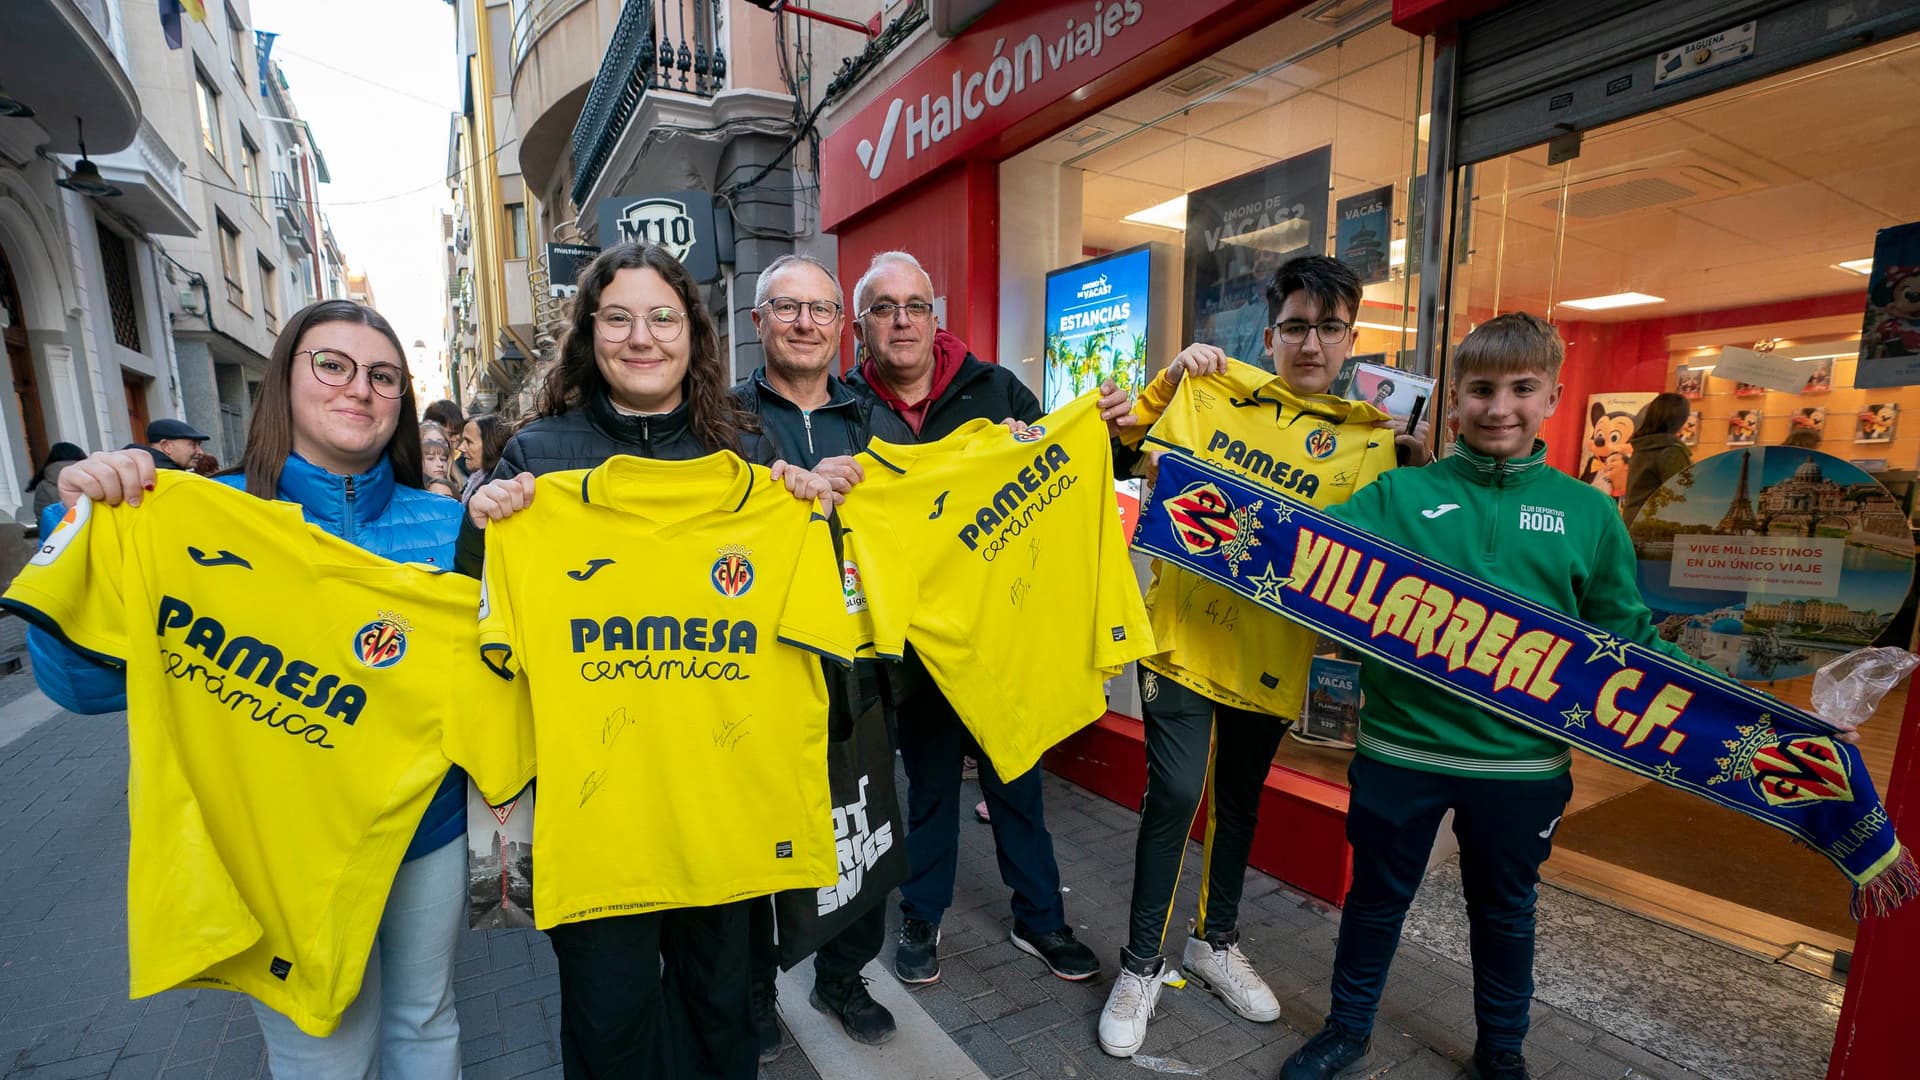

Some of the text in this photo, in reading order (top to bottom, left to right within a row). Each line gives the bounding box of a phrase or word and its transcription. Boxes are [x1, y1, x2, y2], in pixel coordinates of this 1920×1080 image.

[905, 0, 1143, 160] Halcón viajes
[1265, 195, 1280, 208] DE
[1345, 201, 1383, 220] VACAS
[619, 215, 690, 246] M10
[1060, 302, 1130, 332] ESTANCIAS
[1207, 429, 1320, 499] PAMESA
[957, 442, 1071, 551] PAMESA
[1520, 504, 1535, 513] CLUB
[982, 473, 1078, 563] cerámica
[1519, 511, 1565, 535] RODA
[1687, 558, 1822, 574] EN UN ÚNICO VIAJE
[1690, 544, 1823, 558] VIVE MIL DESTINOS
[570, 615, 758, 654] PAMESA
[1287, 526, 1574, 703] VILLARREAL
[1594, 667, 1695, 755] C.F.
[157, 595, 367, 726] PAMESA
[580, 655, 750, 682] cerámica
[1317, 675, 1353, 690] VACAS
[1831, 802, 1888, 859] VILLARRE
